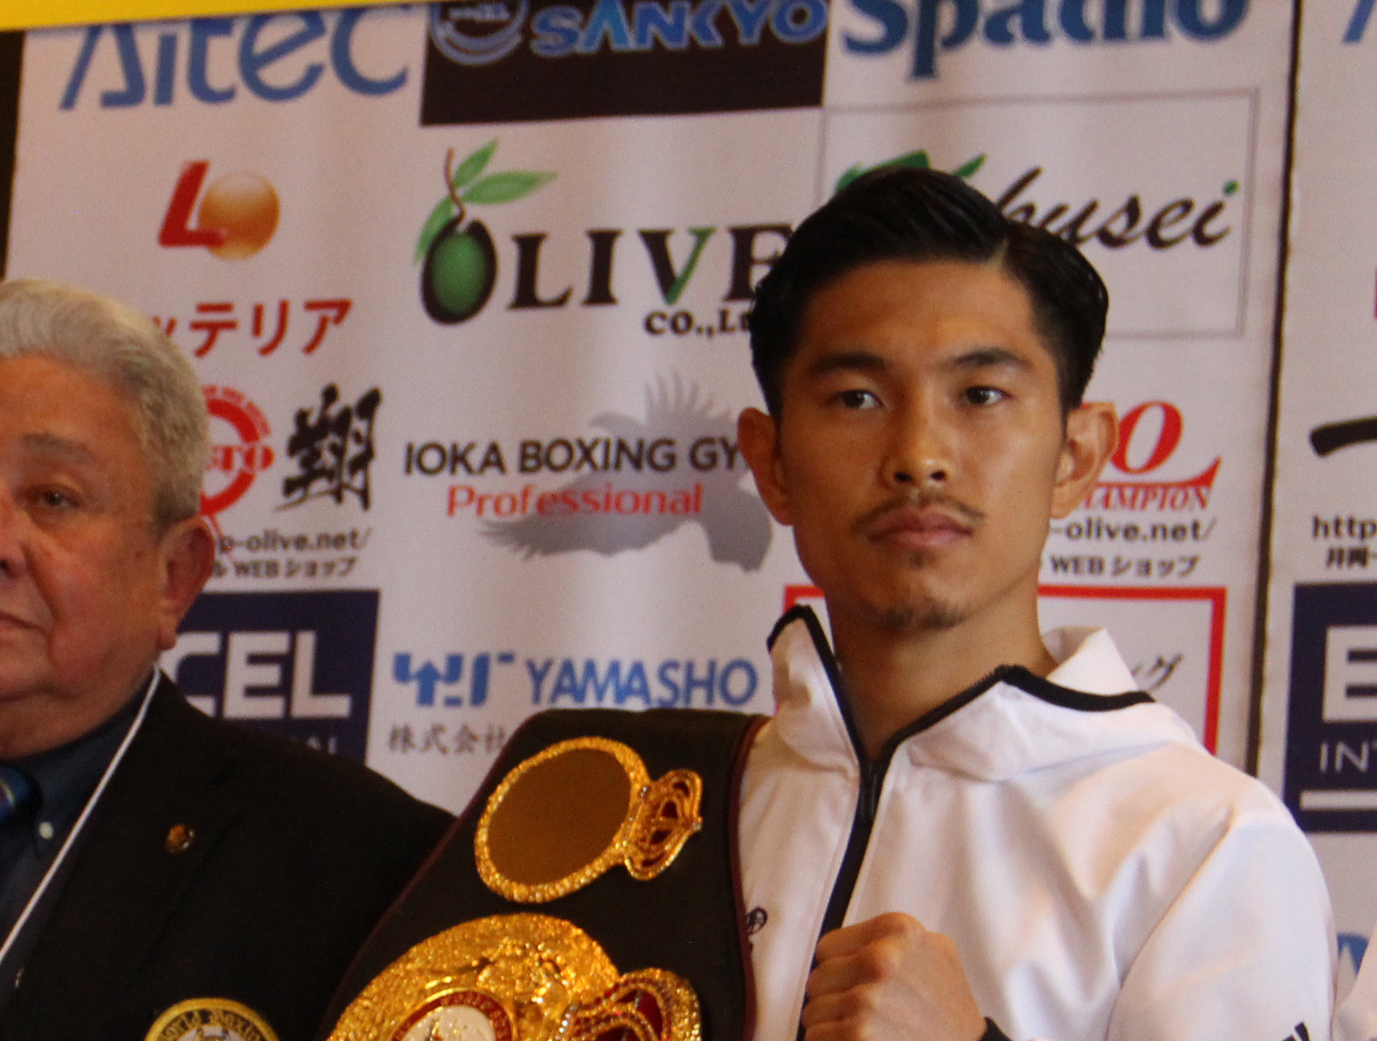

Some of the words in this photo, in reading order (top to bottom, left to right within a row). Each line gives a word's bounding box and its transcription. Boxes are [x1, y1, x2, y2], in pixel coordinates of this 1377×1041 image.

[404, 439, 506, 476] IOKA
[519, 435, 677, 474] BOXING
[689, 435, 751, 472] GY
[446, 481, 704, 518] Professional
[525, 656, 759, 707] YAMASHO
